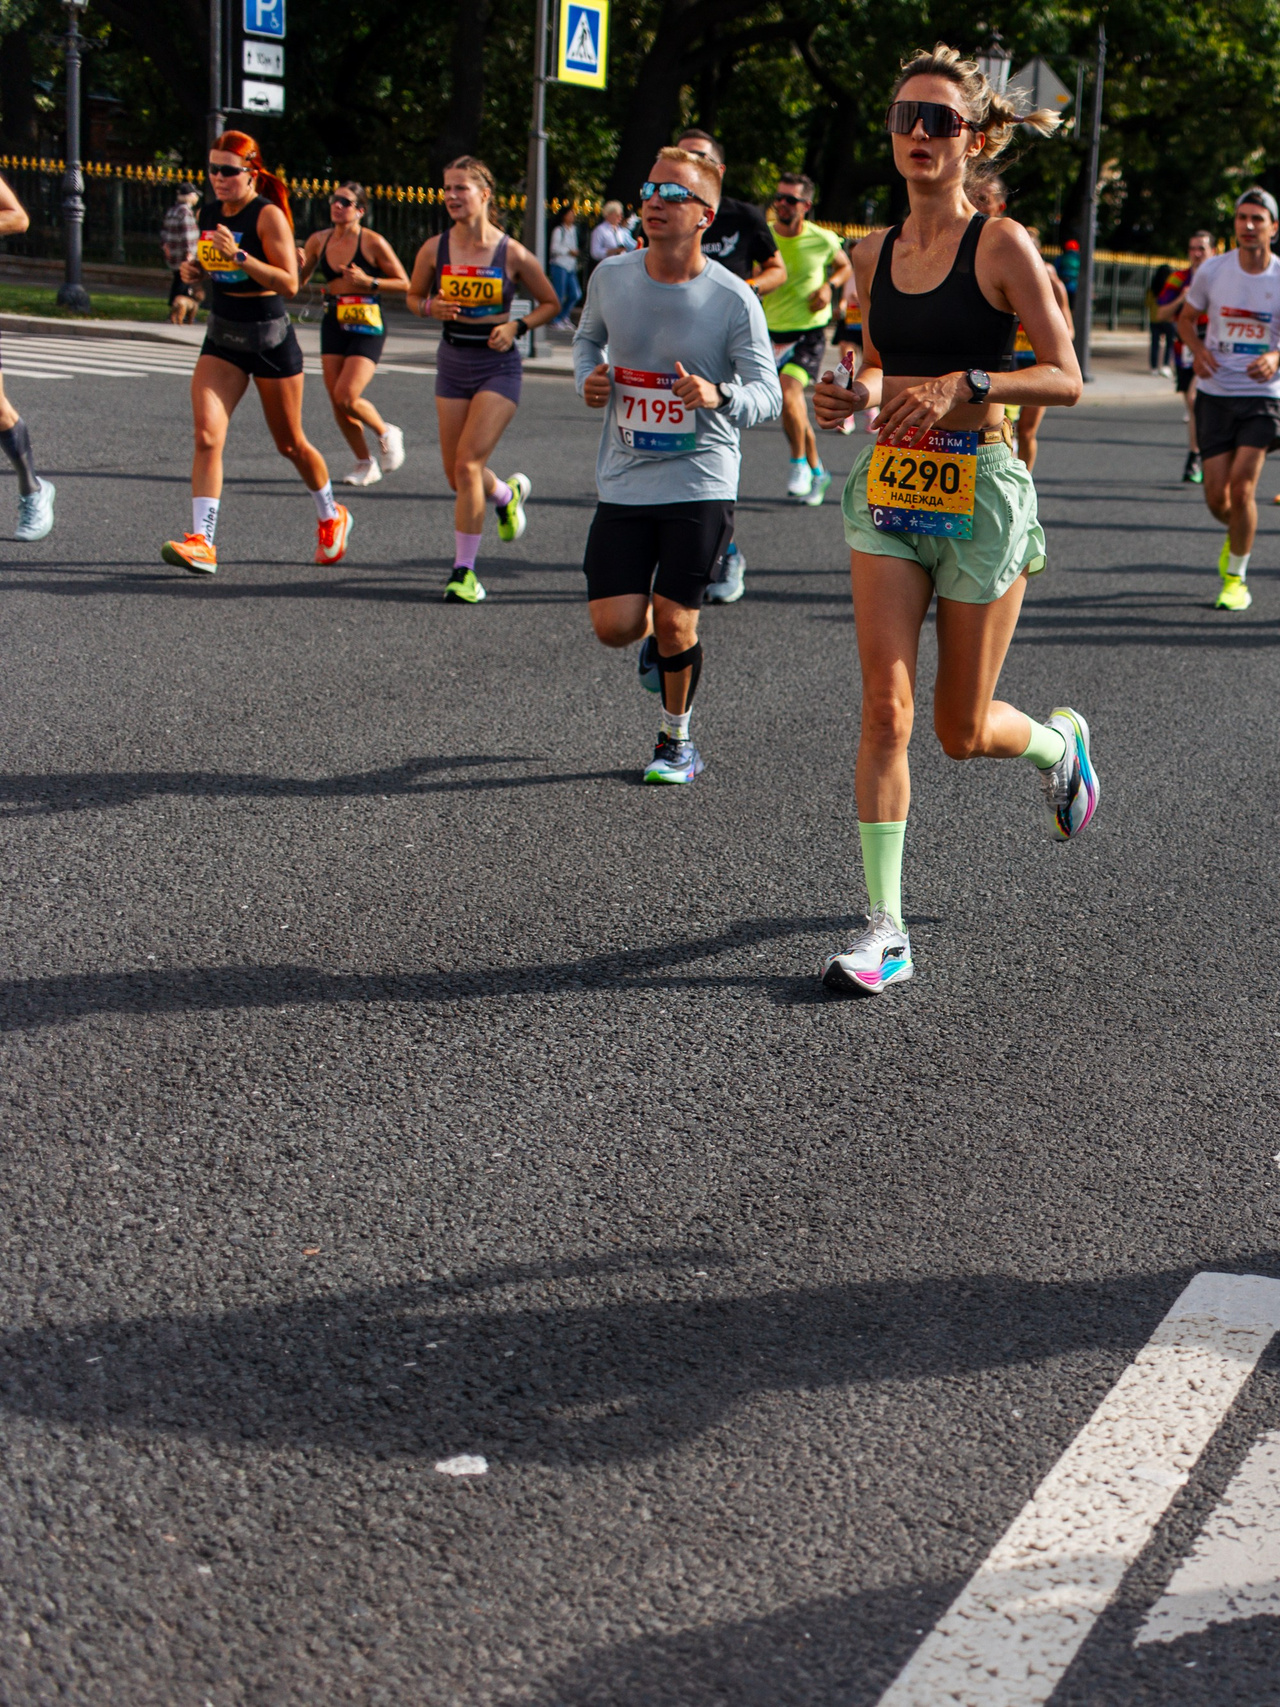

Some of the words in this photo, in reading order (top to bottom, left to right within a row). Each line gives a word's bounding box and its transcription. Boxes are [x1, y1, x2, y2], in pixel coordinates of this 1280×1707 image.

[202, 246, 235, 262] 50
[449, 281, 494, 299] 3670
[1226, 322, 1265, 339] 7753
[622, 395, 684, 425] 7195
[625, 431, 631, 444] C
[928, 436, 945, 446] 21,1
[879, 456, 960, 494] 4290
[890, 492, 944, 507] НАДЕЖДА
